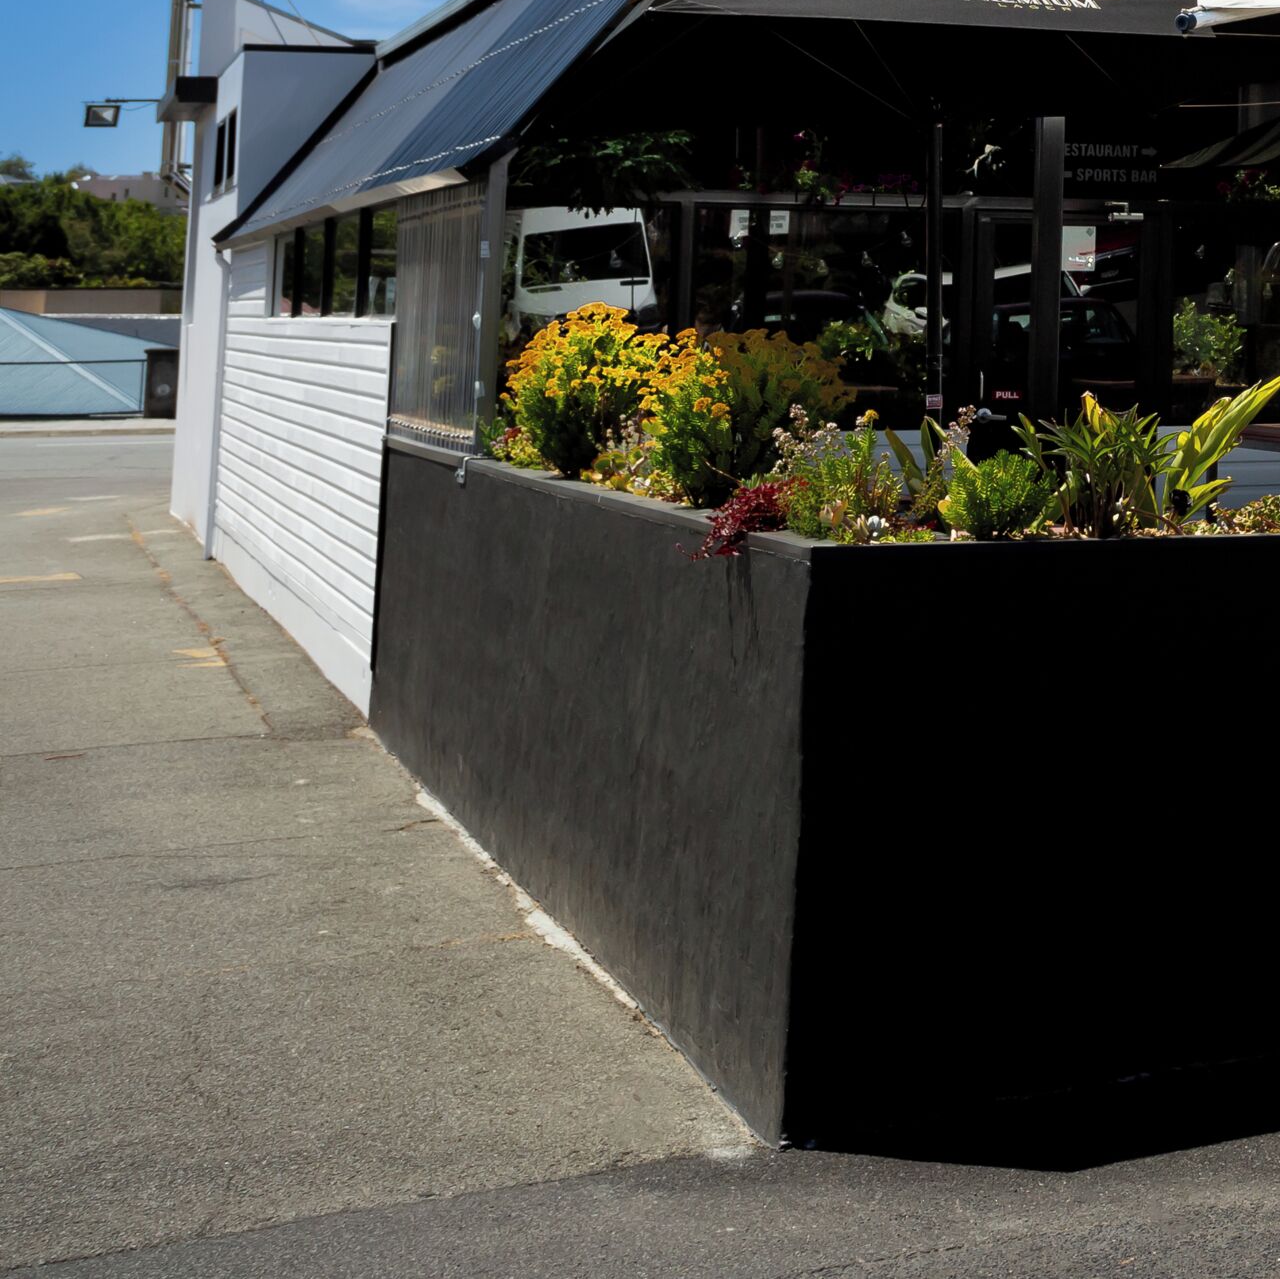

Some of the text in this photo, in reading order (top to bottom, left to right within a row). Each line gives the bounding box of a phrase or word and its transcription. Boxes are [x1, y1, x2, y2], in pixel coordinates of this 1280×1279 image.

[1064, 143, 1139, 158] ESTAURANT
[1076, 168, 1158, 183] SPORTS BAR
[995, 390, 1020, 399] PULL
